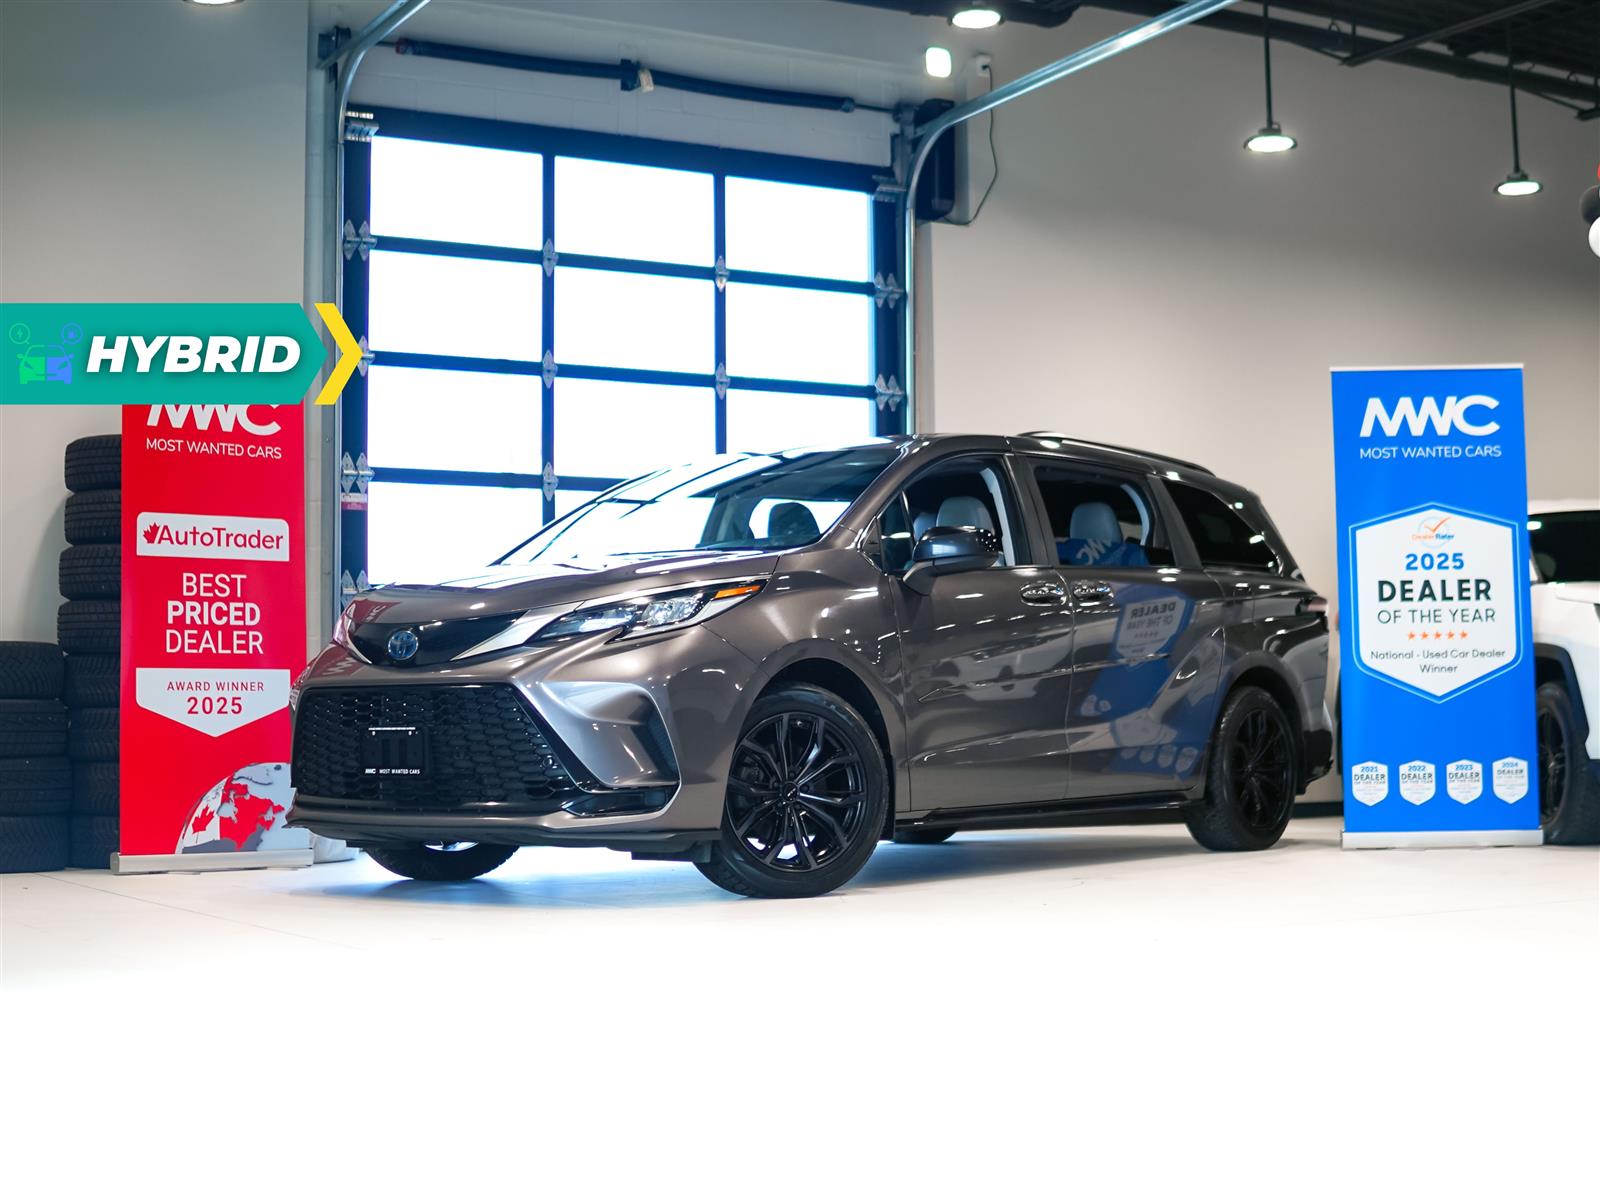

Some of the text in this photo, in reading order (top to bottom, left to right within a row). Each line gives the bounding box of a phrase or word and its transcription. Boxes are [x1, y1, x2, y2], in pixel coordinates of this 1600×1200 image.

[1359, 394, 1501, 438] MWC
[146, 437, 283, 460] MOST WANTED CARS
[1359, 445, 1502, 459] MOST WANTED CARS
[157, 523, 284, 550] AutoTrader
[1405, 552, 1465, 571] 2025
[182, 572, 247, 598] BEST
[1378, 579, 1492, 602] DEALER
[167, 600, 261, 627] PRICED
[1377, 608, 1496, 624] OF THE YEAR
[165, 629, 264, 655] DEALER
[1370, 650, 1414, 660] National
[1422, 649, 1448, 659] Used
[1450, 649, 1469, 658] Car
[1472, 648, 1506, 658] Dealer
[1419, 664, 1458, 673] Winner
[166, 681, 265, 692] AWARD WINNER
[187, 696, 243, 715] 2025
[1354, 773, 1386, 781] DEALER
[1448, 772, 1480, 780] DEALER
